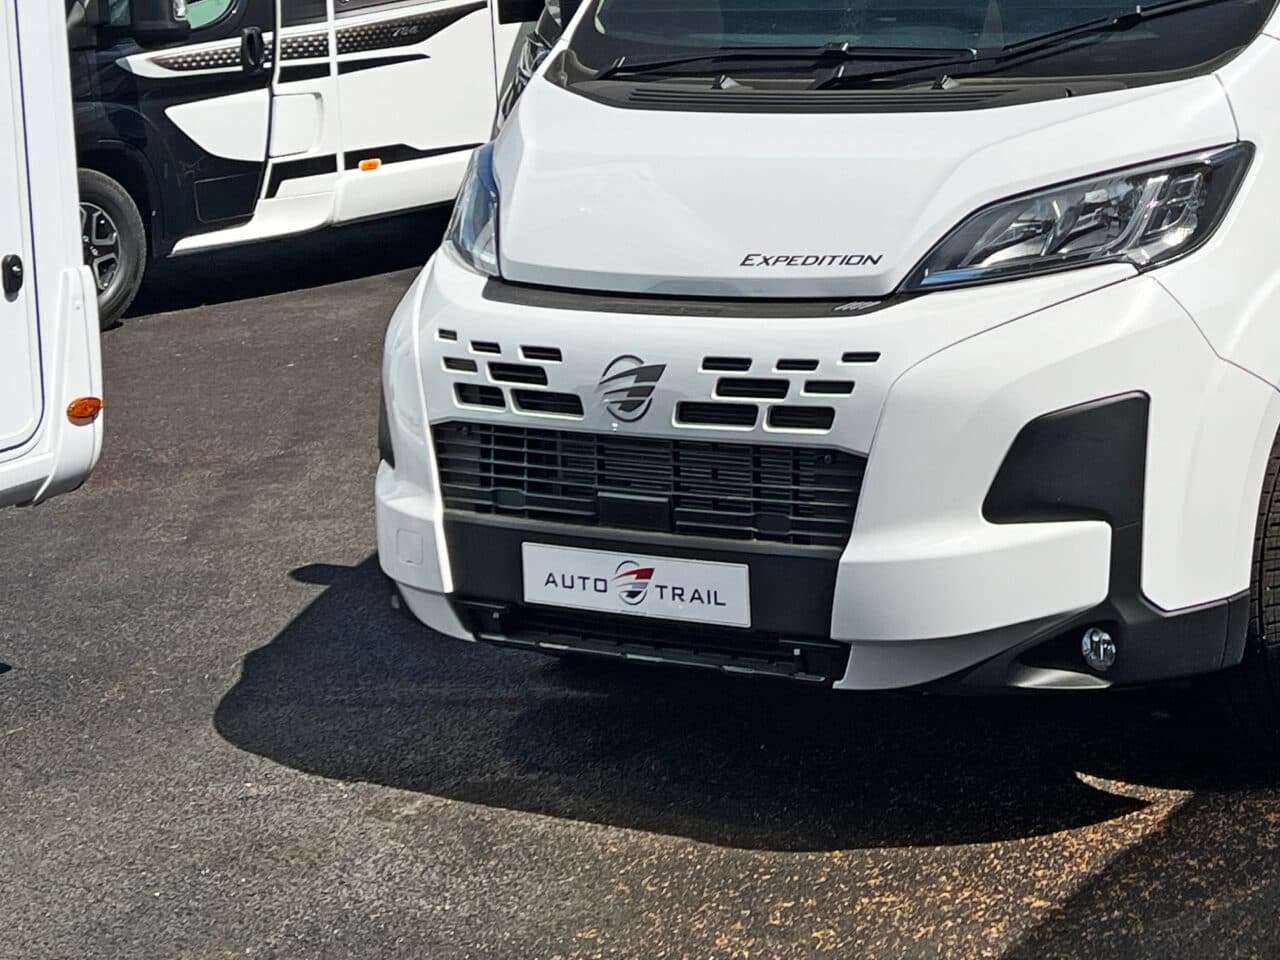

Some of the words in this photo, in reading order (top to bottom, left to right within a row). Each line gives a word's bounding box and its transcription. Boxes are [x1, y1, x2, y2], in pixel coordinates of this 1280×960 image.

[739, 253, 884, 267] EXPEDITION
[544, 572, 608, 594] AUTO
[655, 584, 727, 607] TRAIL
